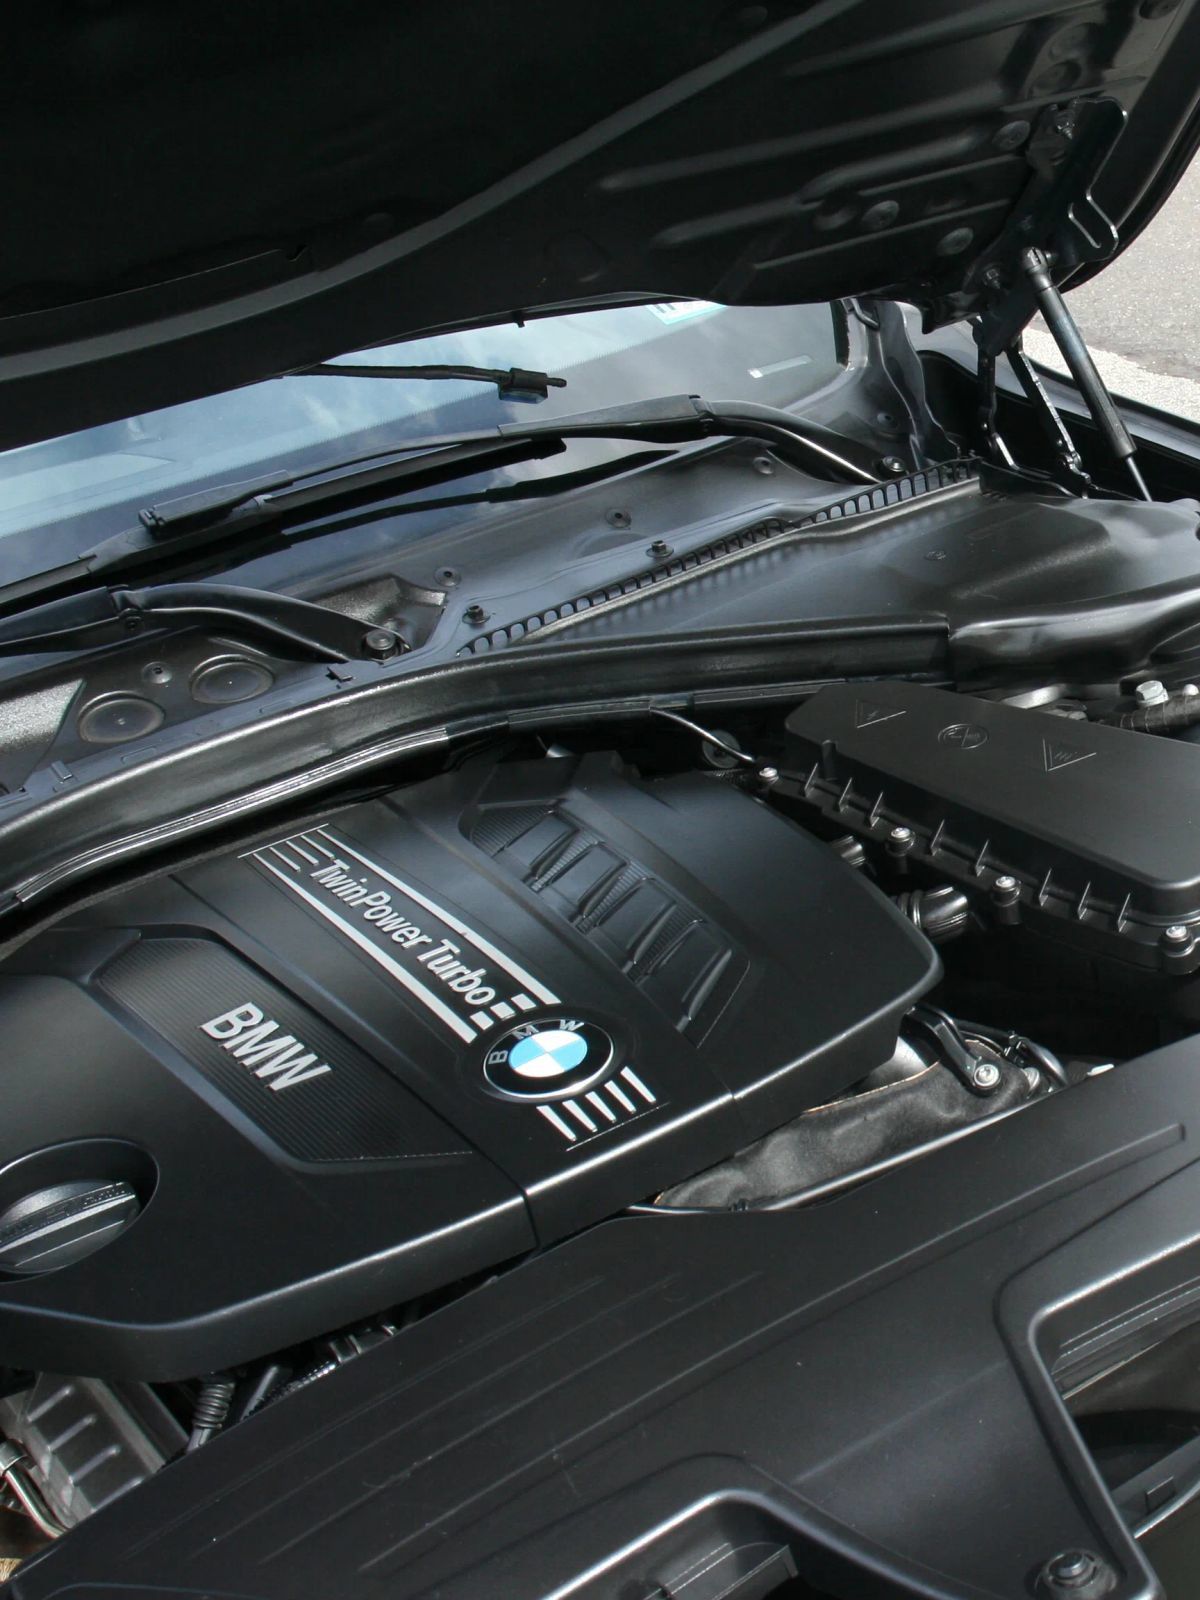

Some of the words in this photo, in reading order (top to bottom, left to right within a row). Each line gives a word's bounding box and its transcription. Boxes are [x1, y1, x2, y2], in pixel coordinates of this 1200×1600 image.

[310, 859, 432, 949] TwinPower
[417, 939, 496, 1005] Turbo
[200, 1002, 332, 1092] BMW
[488, 1019, 585, 1064] BMW
